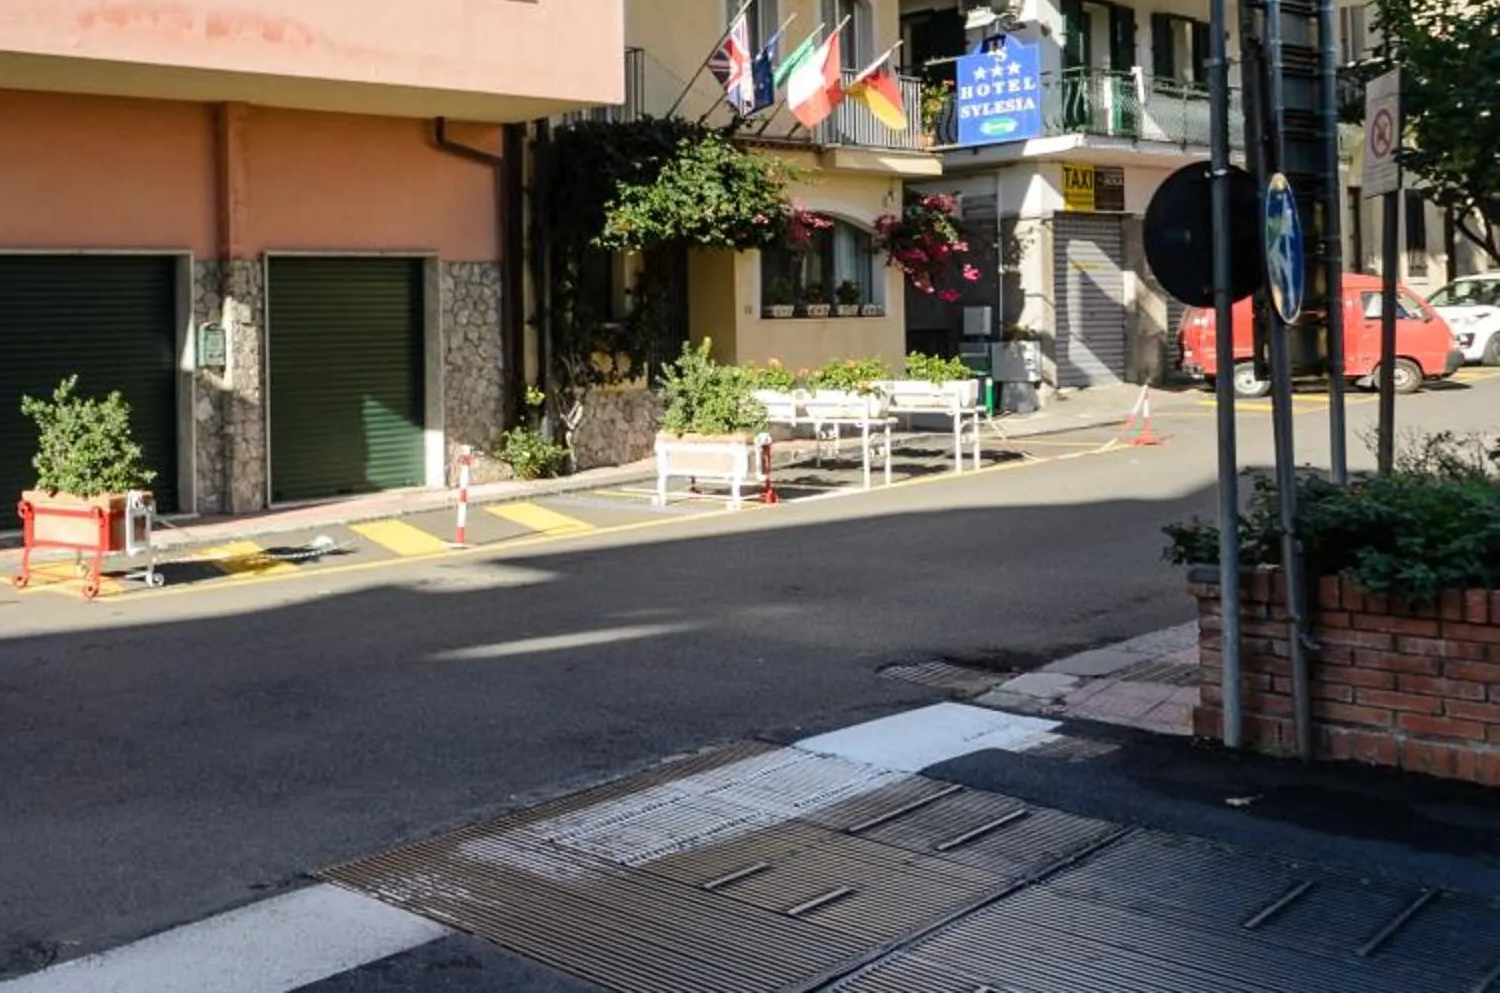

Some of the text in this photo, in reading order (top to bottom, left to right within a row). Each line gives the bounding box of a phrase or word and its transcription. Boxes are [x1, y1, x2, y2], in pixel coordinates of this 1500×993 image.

[960, 77, 1035, 99] HOTEL
[960, 97, 1035, 119] SYLESIA
[1063, 167, 1093, 189] TAXI
